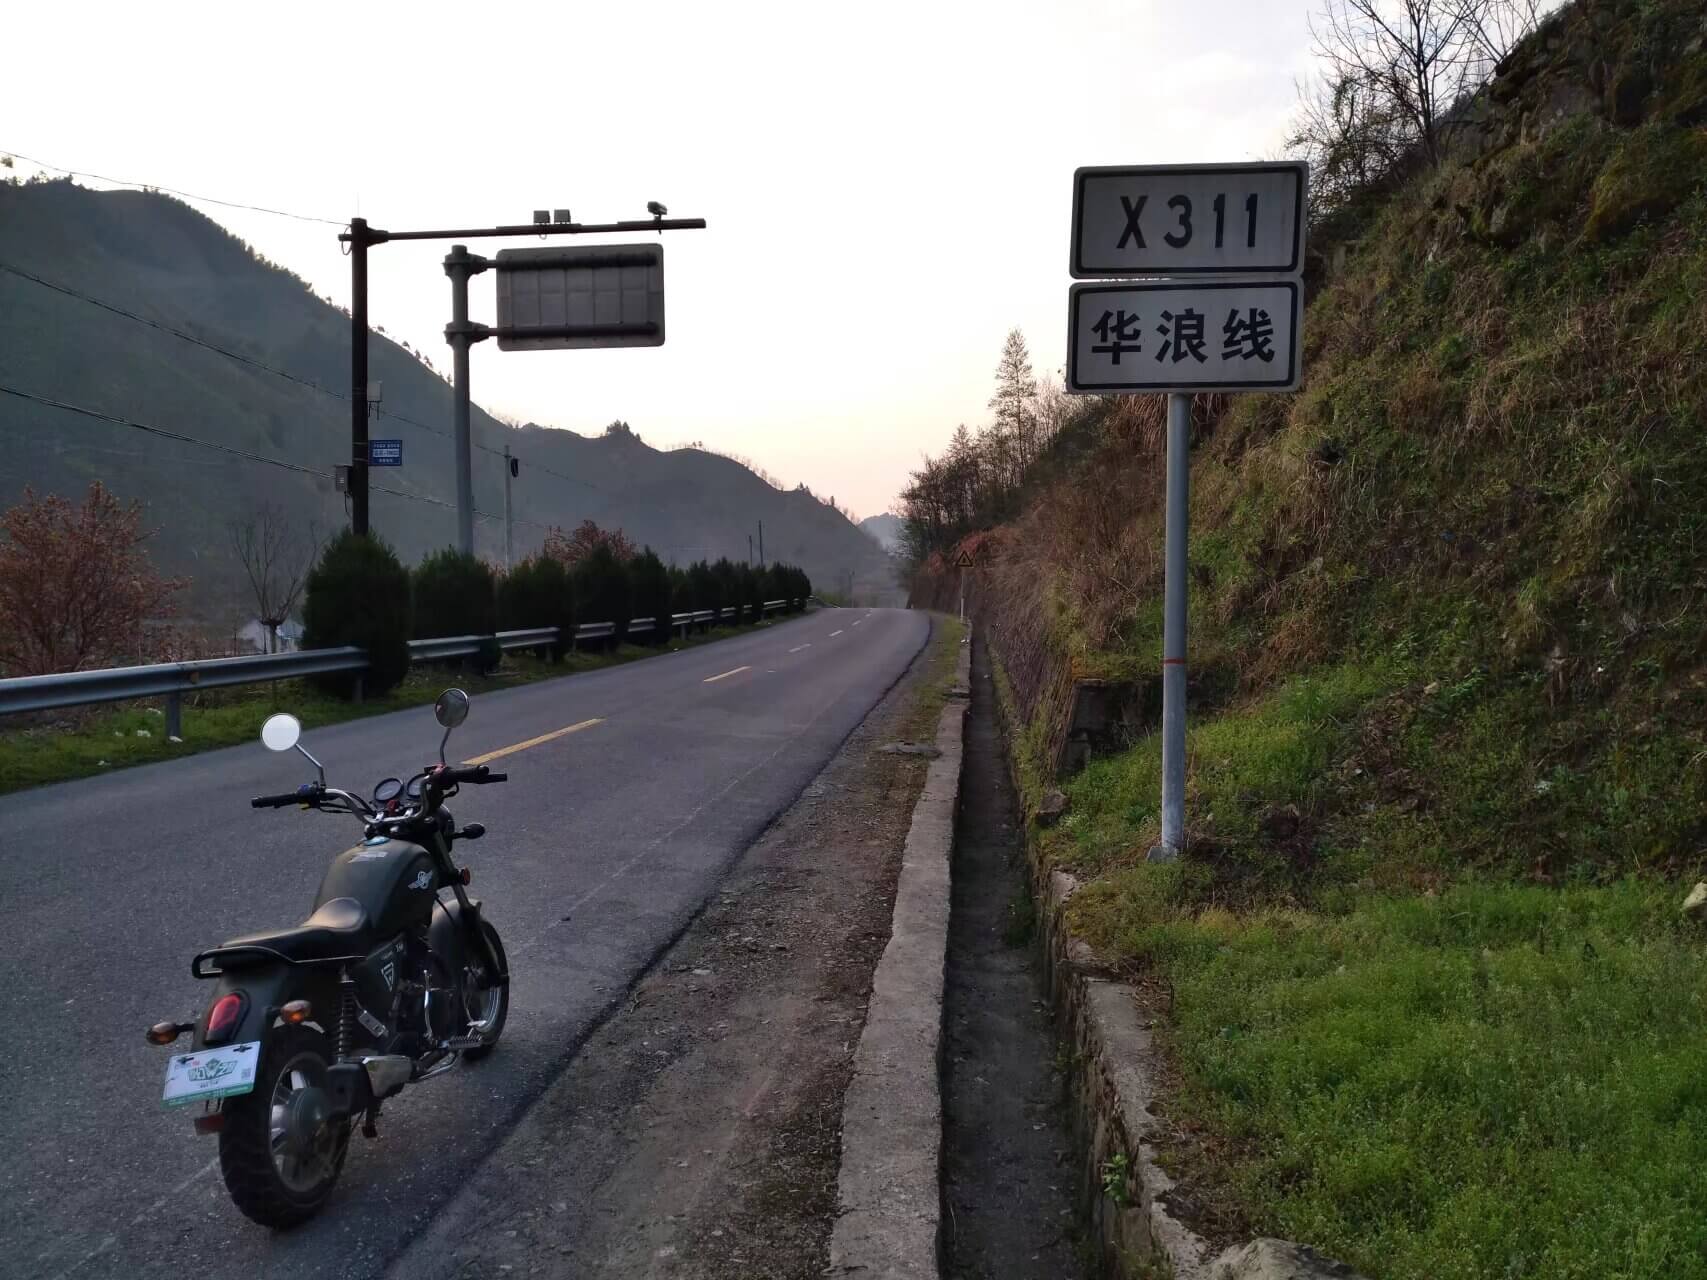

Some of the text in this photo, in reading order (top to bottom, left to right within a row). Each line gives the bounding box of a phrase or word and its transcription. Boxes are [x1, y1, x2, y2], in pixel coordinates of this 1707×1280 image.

[1116, 193, 1258, 249] X311
[1091, 308, 1275, 365] 华浪线
